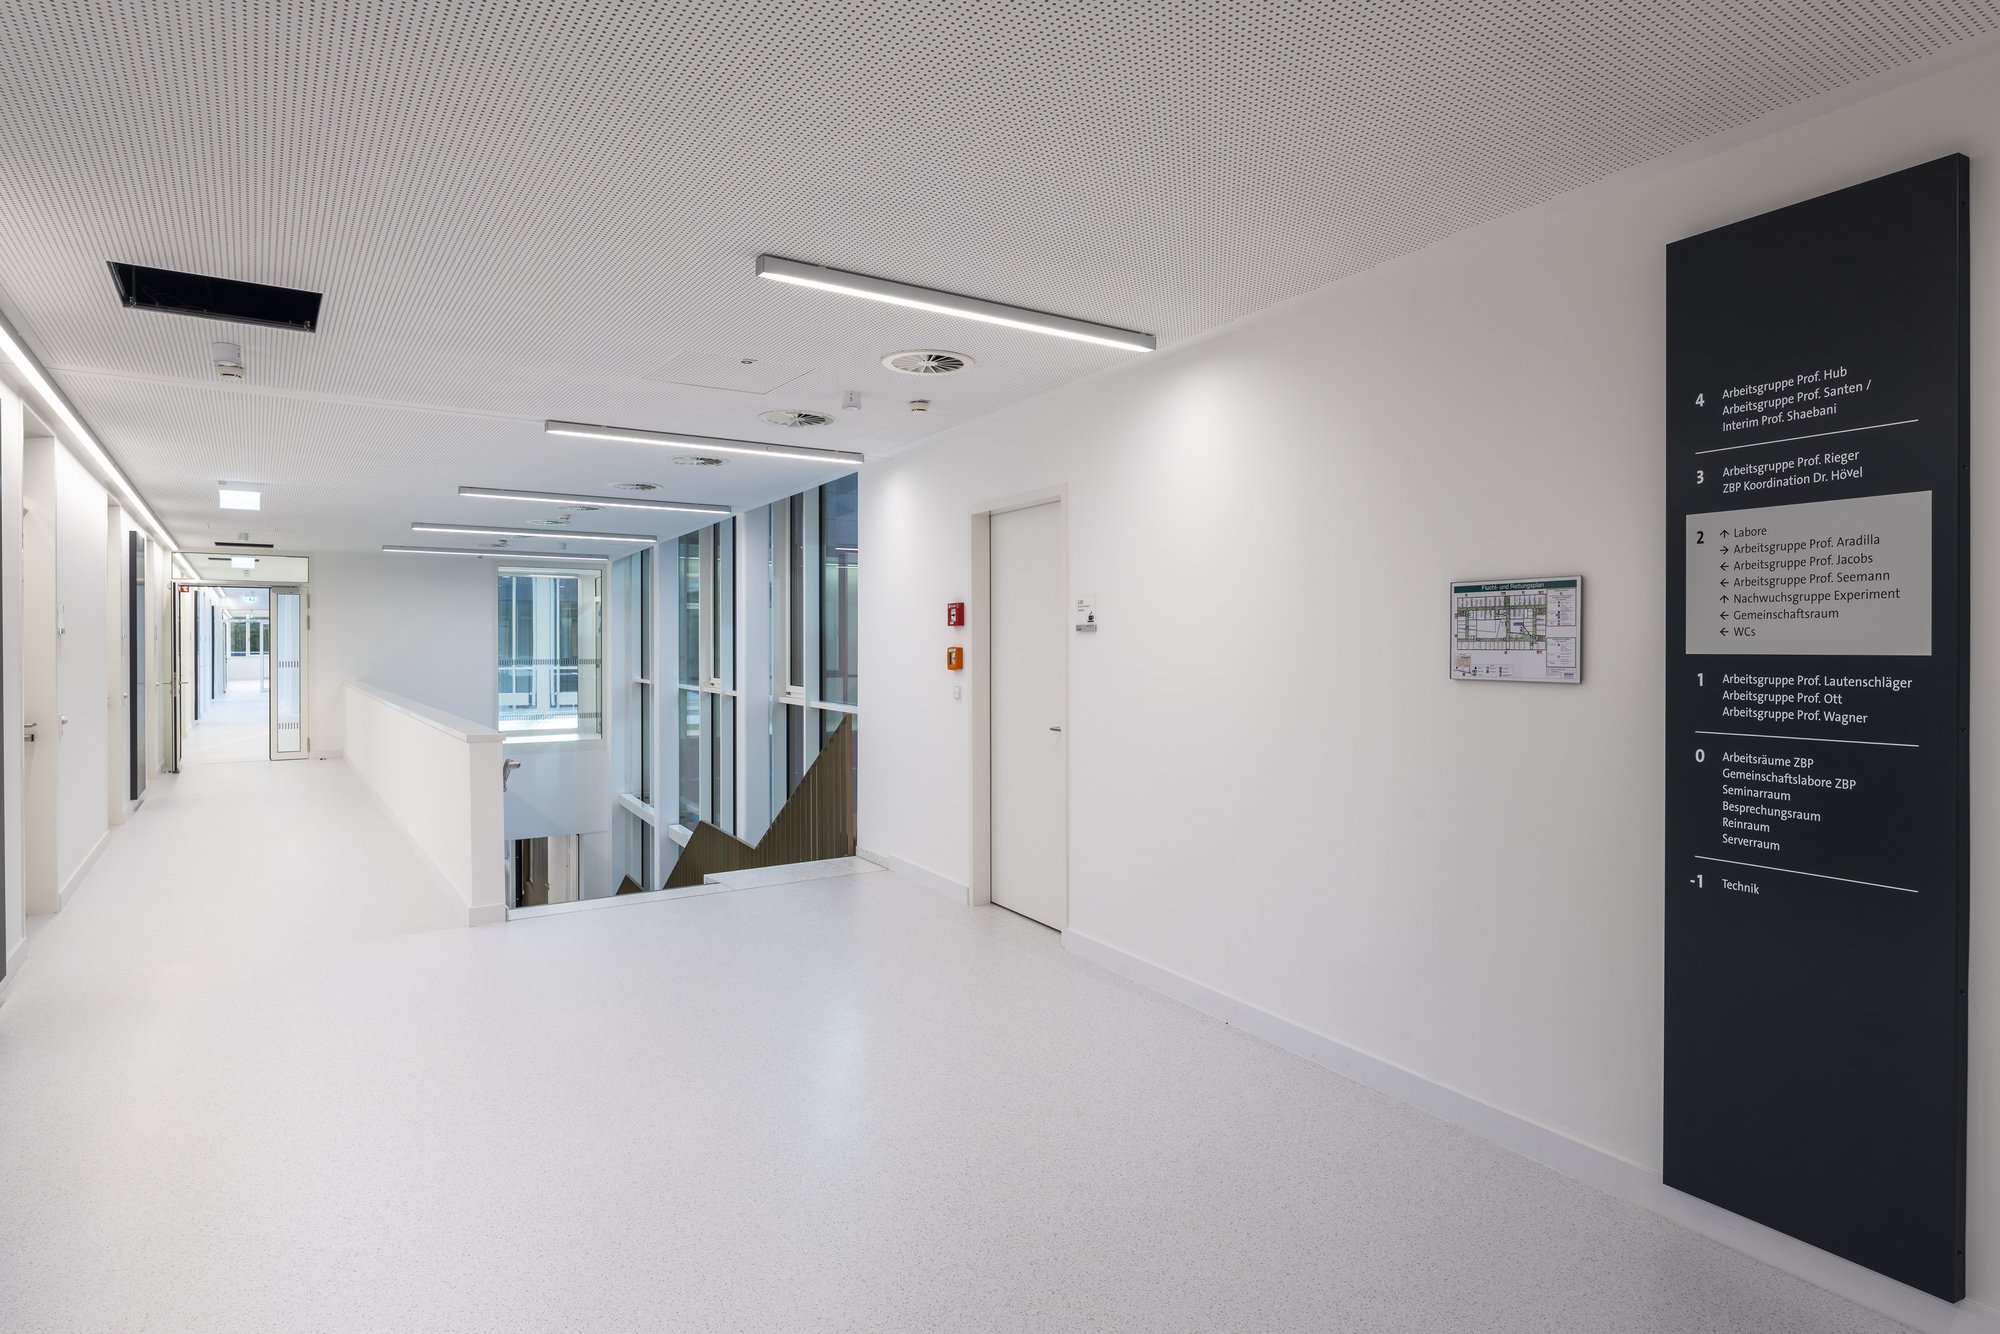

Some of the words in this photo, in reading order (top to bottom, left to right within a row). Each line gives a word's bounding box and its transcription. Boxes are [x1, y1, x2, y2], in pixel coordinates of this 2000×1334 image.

[1722, 377, 1794, 399] Arbeitsgruppe
[1797, 372, 1821, 385] Prof.
[1824, 366, 1847, 379] Hub
[1695, 393, 1704, 407] 4
[1722, 394, 1794, 415] Arbeitsgruppe
[1797, 389, 1821, 402] Prof.
[1824, 382, 1862, 398] Santen
[1866, 380, 1871, 390] /
[1723, 418, 1758, 432] Interim
[1762, 412, 1784, 425] Prof.
[1787, 404, 1836, 421] Shaebani
[1722, 459, 1794, 477] Arbeitsgruppe
[1797, 455, 1821, 467] Prof.
[1824, 450, 1859, 464] Rieger
[1696, 471, 1704, 484] 3
[1723, 482, 1741, 493] ZBP
[1744, 474, 1810, 491] Koordination
[1814, 472, 1828, 482] Dr.
[1831, 467, 1862, 480] Hövel
[1696, 531, 1704, 544] 2
[1734, 526, 1767, 537] Labore
[1734, 541, 1806, 554] Arbeitsgruppe
[1810, 538, 1833, 549] Prof.
[1836, 535, 1880, 547] Aradilla
[1734, 558, 1806, 571] Arbeitsgruppe
[1810, 555, 1833, 566] Prof.
[1836, 553, 1873, 565] Jacobs
[1734, 574, 1806, 587] Arbeitsgruppe
[1810, 572, 1833, 582] Prof.
[1836, 571, 1889, 582] Seemann
[1734, 591, 1831, 604] Nachwuchsgruppe
[1834, 588, 1900, 601] Experiment
[1734, 609, 1839, 620] Gemeinschaftsraum
[1734, 627, 1756, 636] WCs
[1697, 673, 1703, 686] 1
[1723, 674, 1794, 688] Arbeitsgruppe
[1797, 677, 1821, 686] Prof.
[1824, 676, 1912, 691] Lautenschläger
[1723, 691, 1794, 704] Arbeitsgruppe
[1797, 693, 1821, 704] Prof.
[1824, 694, 1842, 704] Ott
[1723, 707, 1794, 722] Arbeitsgruppe
[1797, 711, 1821, 721] Prof.
[1824, 712, 1867, 725] Wagner
[1695, 749, 1705, 762] 0
[1723, 752, 1791, 767] Arbeitsräume
[1794, 757, 1814, 768] ZBP
[1722, 769, 1832, 788] Gemeinschaftslabore
[1835, 778, 1856, 789] ZBP
[1722, 785, 1791, 800] Seminarraum
[1722, 801, 1821, 822] Besprechungsraum
[1722, 817, 1770, 832] Reinraum
[1722, 834, 1780, 850] Serverraum
[1690, 875, 1703, 888] -1
[1722, 878, 1759, 895] Technik
